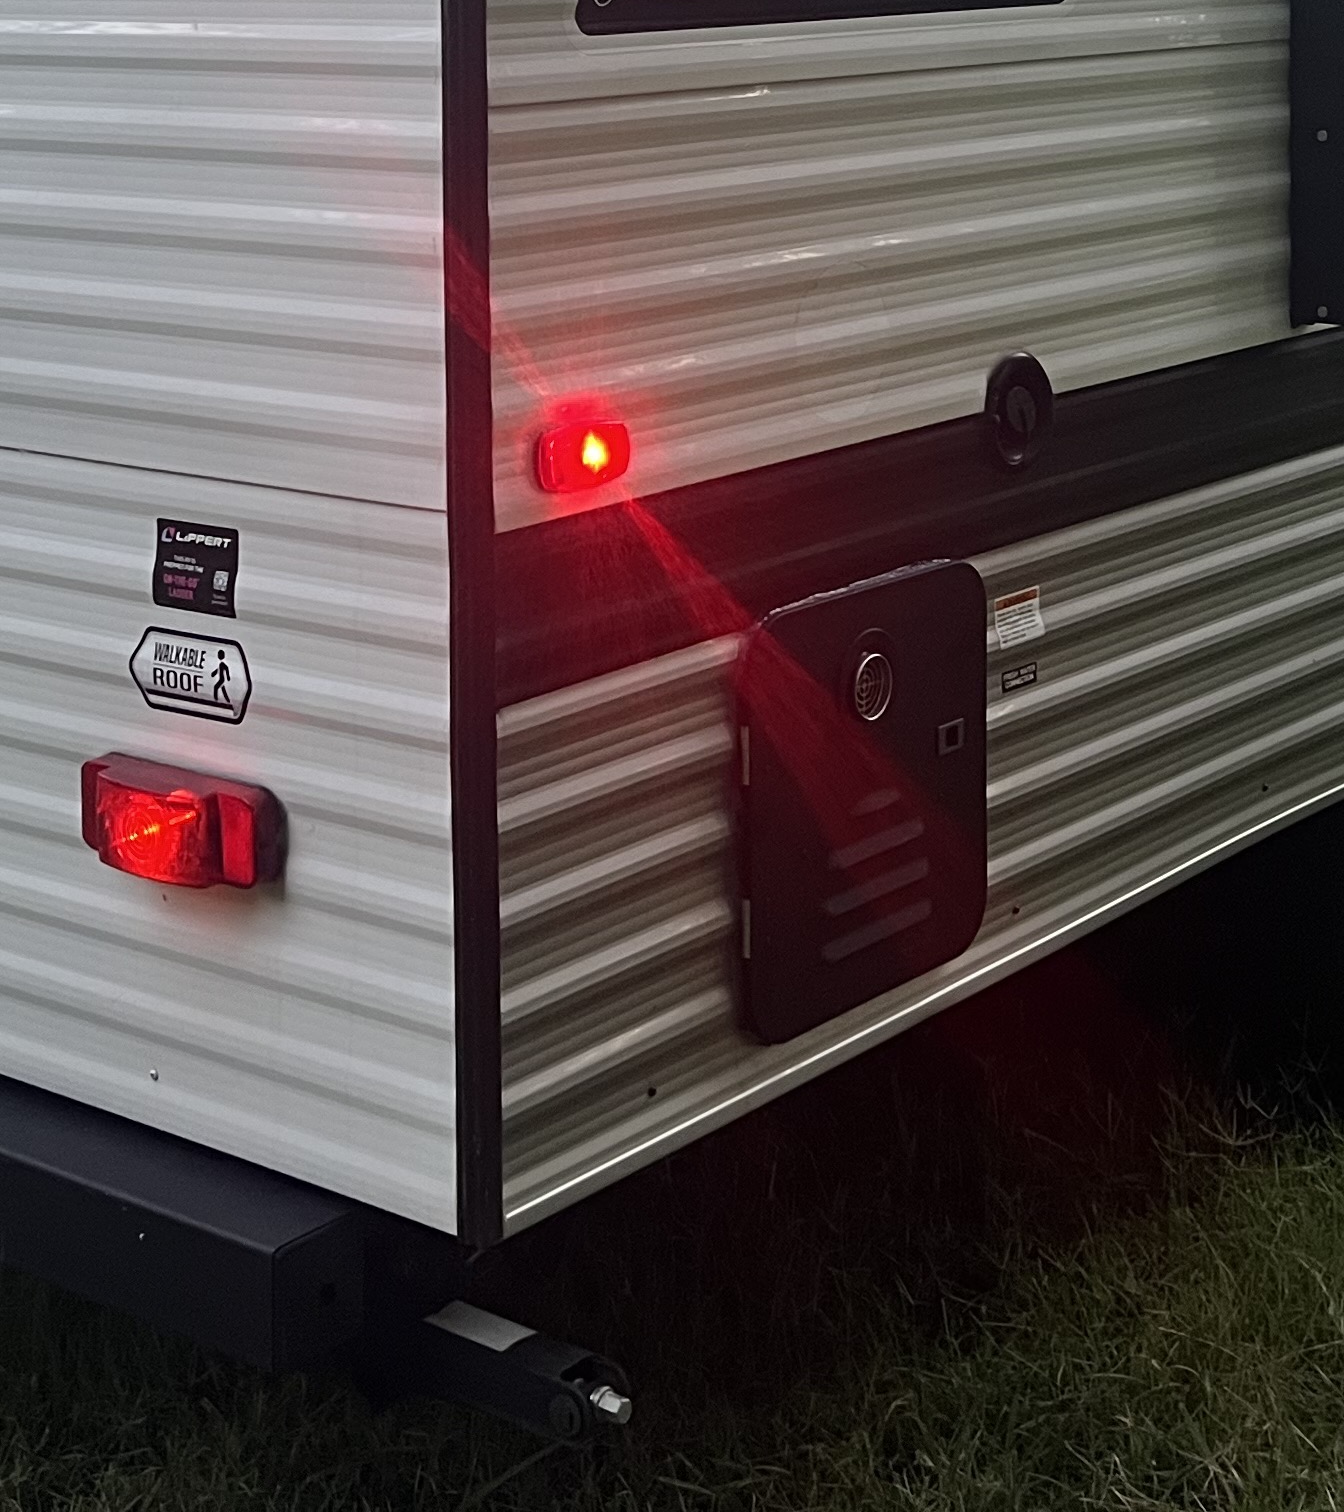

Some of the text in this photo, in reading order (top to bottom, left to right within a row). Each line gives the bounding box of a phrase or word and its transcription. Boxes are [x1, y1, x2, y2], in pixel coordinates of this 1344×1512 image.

[175, 531, 232, 548] LIPPERT
[153, 641, 207, 669] WALKABLE
[152, 666, 204, 693] ROOF
